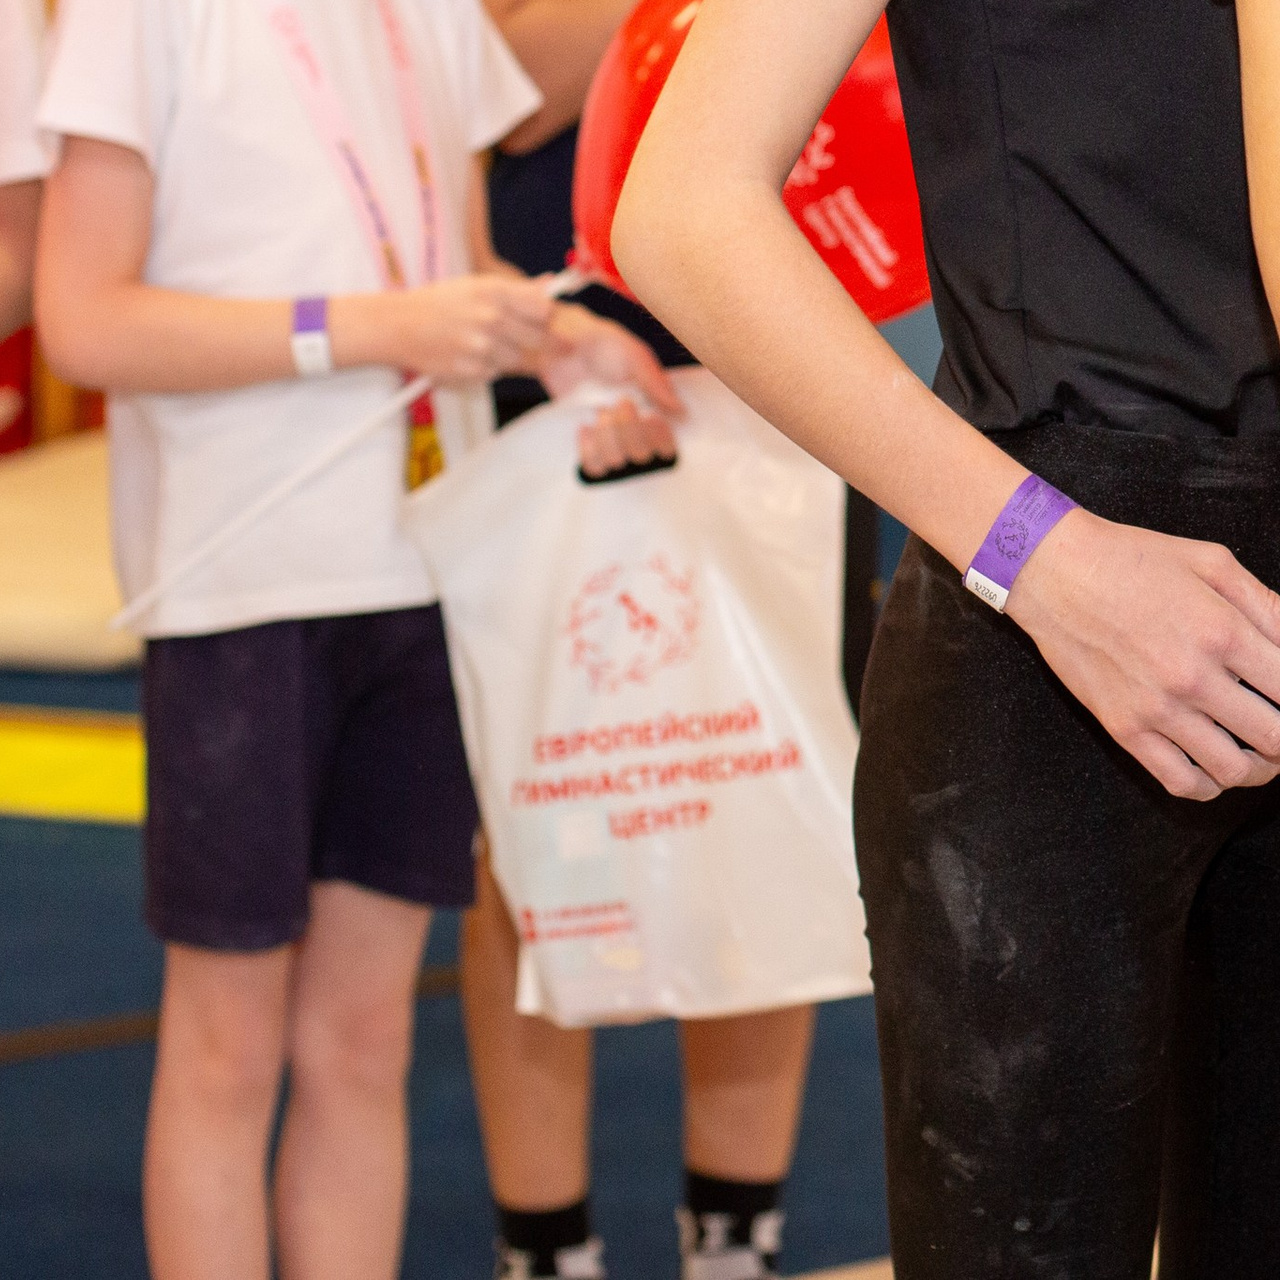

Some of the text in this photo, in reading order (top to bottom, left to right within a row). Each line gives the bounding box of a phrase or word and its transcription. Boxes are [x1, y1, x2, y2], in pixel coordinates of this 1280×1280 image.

[533, 703, 760, 764] ЕВРОПЕЙСКИЙ
[511, 741, 802, 805] ГИМНАСТИЧЕСКИЙ
[609, 800, 711, 838] ЦЕНТР
